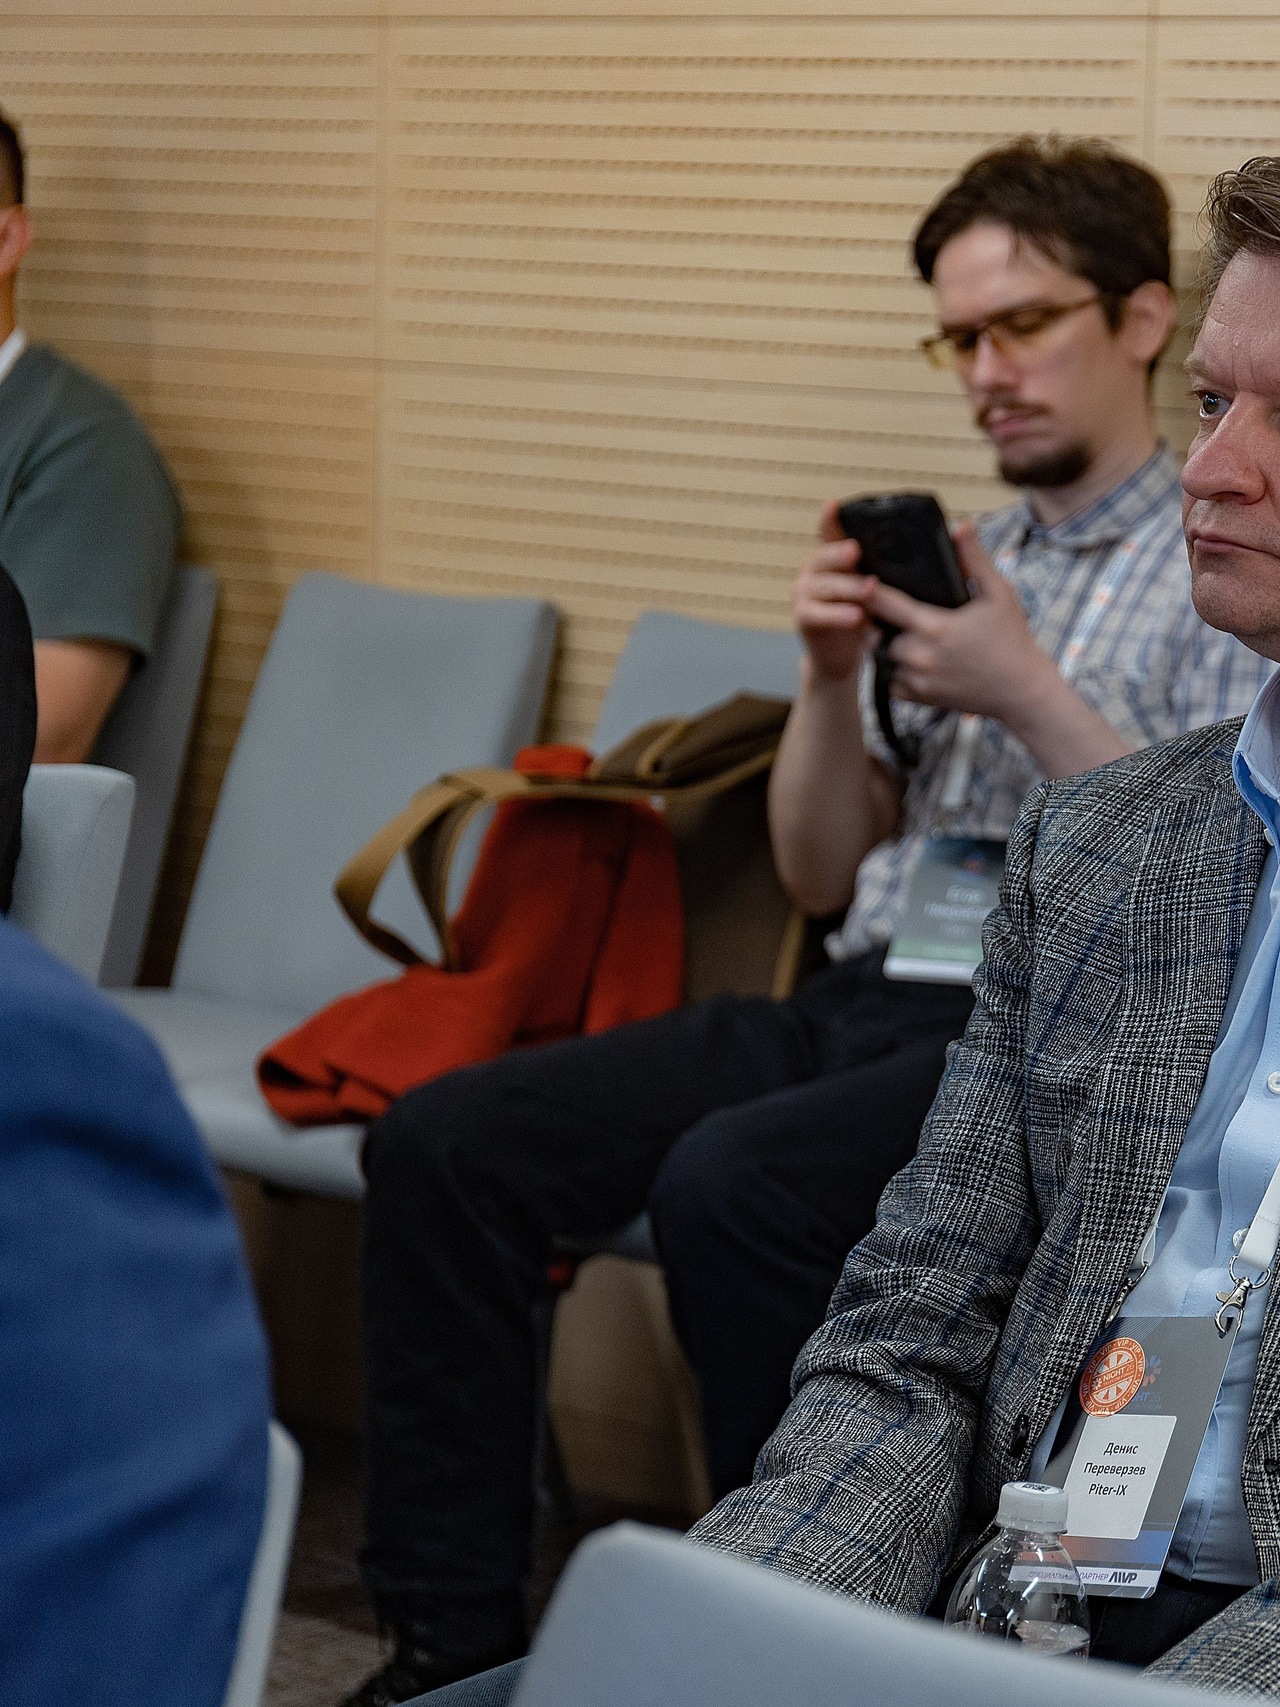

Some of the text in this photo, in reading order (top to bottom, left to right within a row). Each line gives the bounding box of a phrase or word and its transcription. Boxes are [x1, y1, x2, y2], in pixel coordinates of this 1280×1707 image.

[1100, 1344, 1112, 1356] VIP
[1131, 1343, 1141, 1354] VIP
[1103, 1366, 1125, 1382] NIGHT
[1081, 1382, 1089, 1396] VIP
[1130, 1379, 1140, 1394] VIP
[1085, 1401, 1095, 1411] VIP
[1115, 1398, 1127, 1409] VIP
[1103, 1442, 1139, 1456] Денис
[1083, 1462, 1146, 1477] Переверзев
[1088, 1483, 1128, 1496] Piter-IX
[1079, 1572, 1109, 1580] ПАРТНЕР
